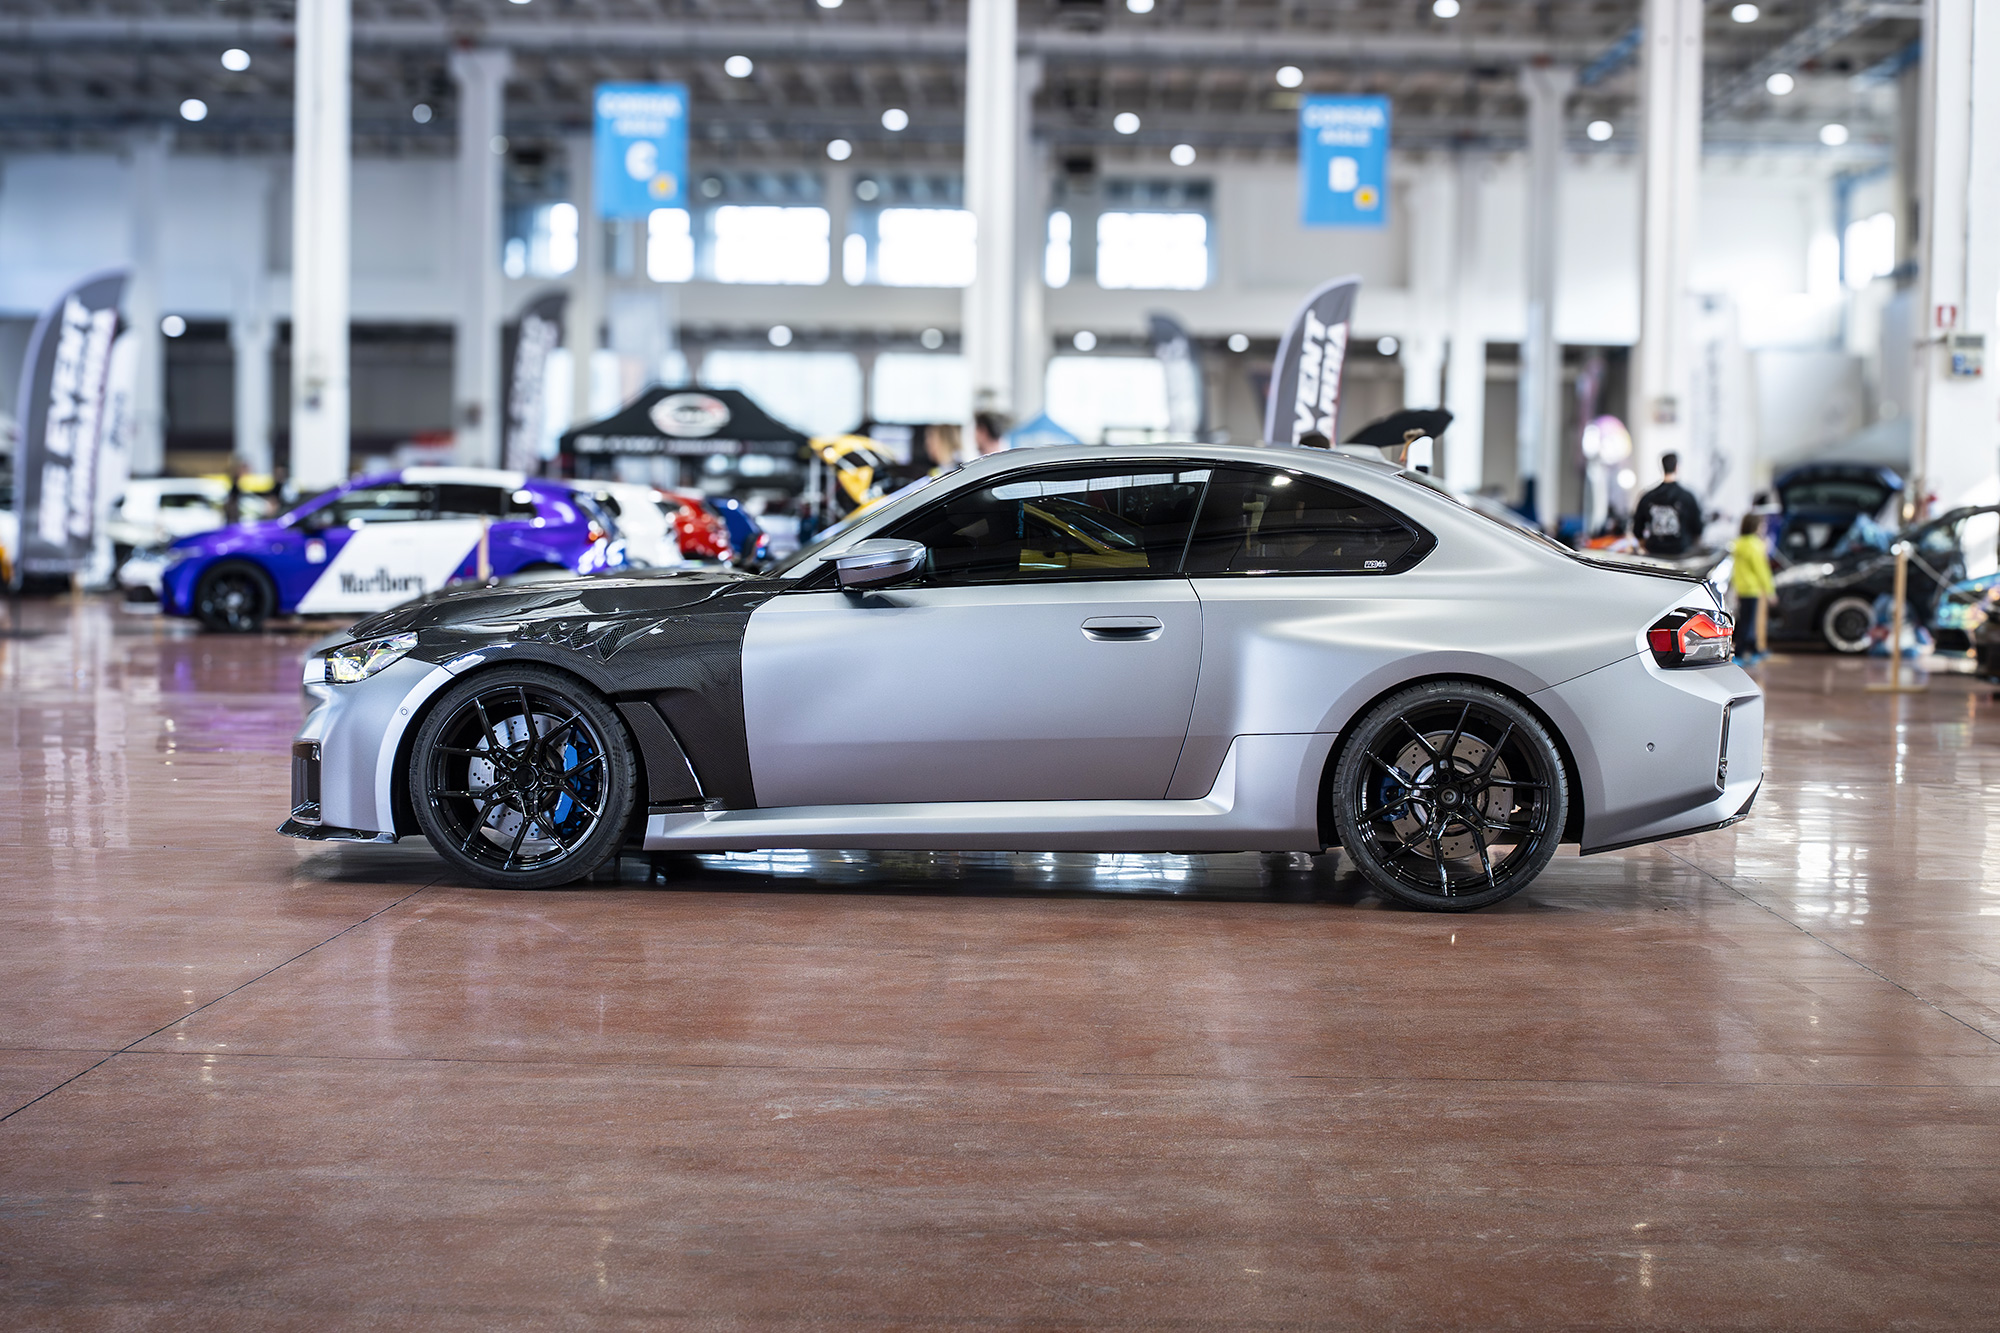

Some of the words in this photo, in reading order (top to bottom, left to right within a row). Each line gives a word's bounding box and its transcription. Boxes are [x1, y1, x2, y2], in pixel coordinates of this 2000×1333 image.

[625, 140, 659, 181] C
[1328, 156, 1359, 192] B
[1292, 309, 1327, 447] VENT
[1316, 322, 1348, 445] ARDIA
